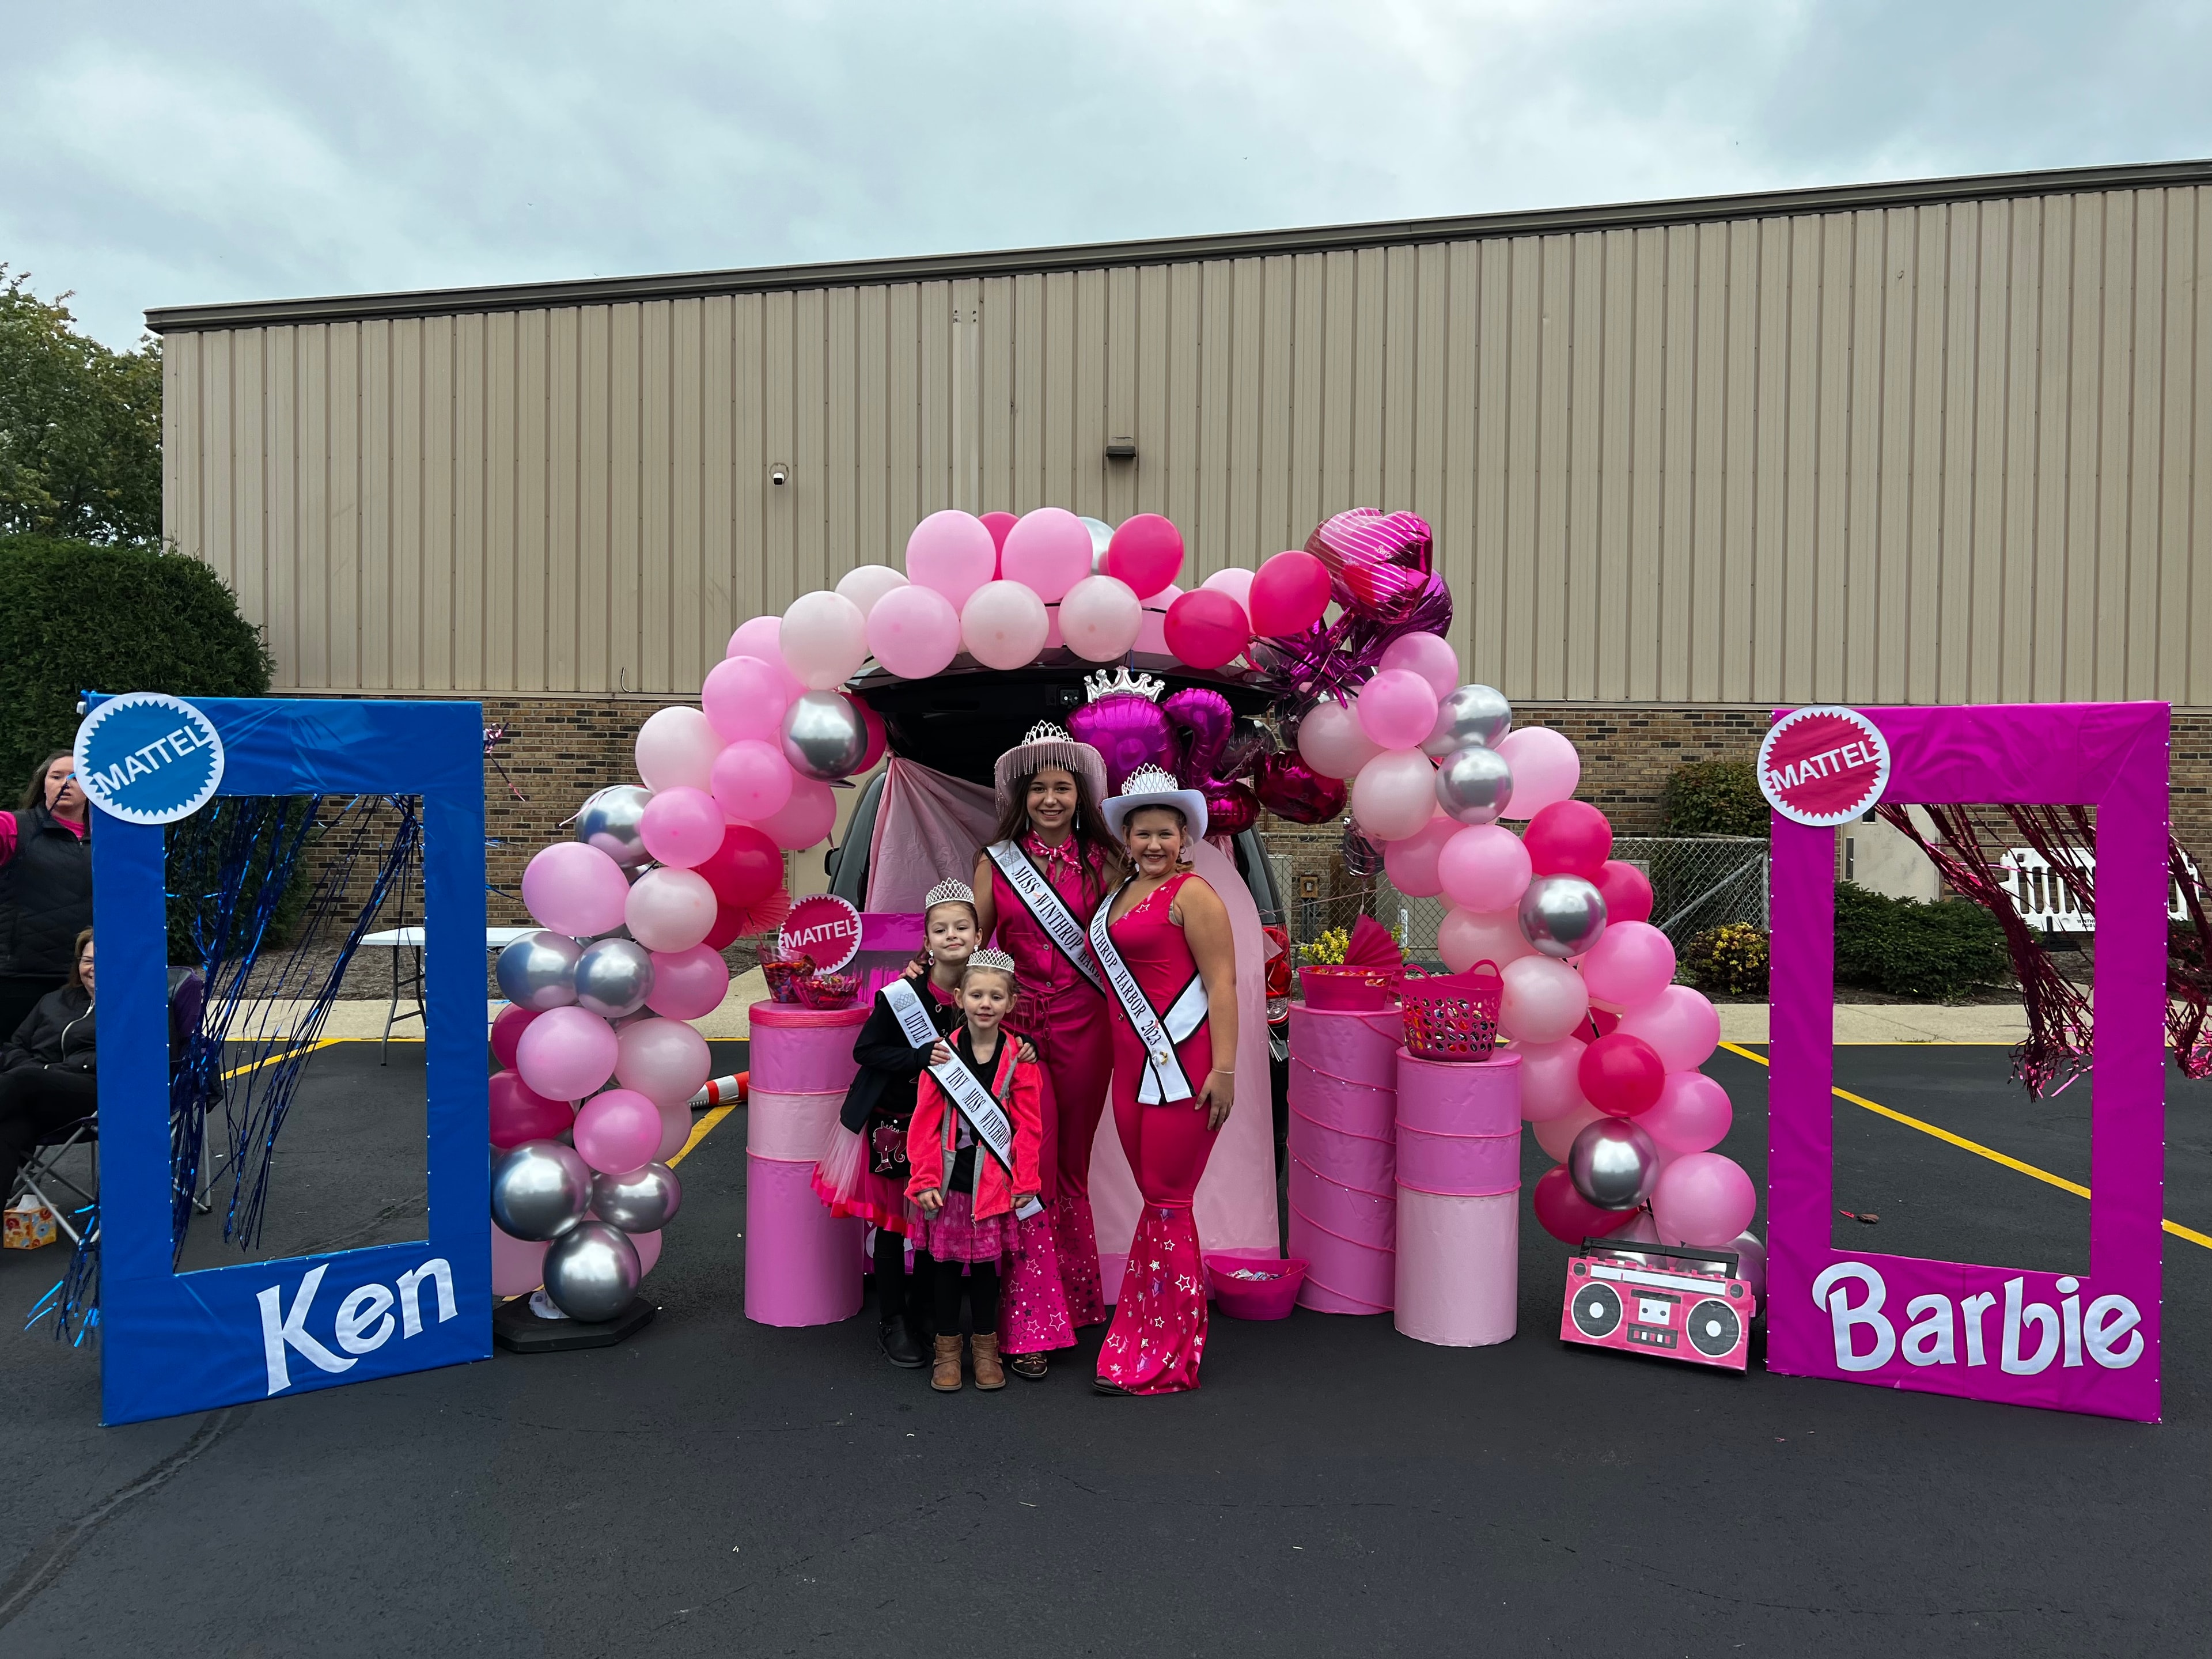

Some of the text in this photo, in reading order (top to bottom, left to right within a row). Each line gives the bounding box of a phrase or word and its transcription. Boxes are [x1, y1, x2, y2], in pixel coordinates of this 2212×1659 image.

[93, 725, 212, 796] MATTEL
[1771, 741, 1877, 791] MATTEL
[783, 919, 858, 949] MATTEL
[1012, 865, 1041, 894] MISS
[1034, 892, 1084, 950] WINTHROP
[1092, 912, 1118, 968] WINTHROP
[1115, 971, 1147, 1020] HARBOR
[1141, 1020, 1161, 1046] 2023
[904, 1011, 932, 1043] LITTLE
[946, 1067, 1010, 1150] TINY MISS WINTHROP
[256, 1258, 458, 1396] Ken
[1812, 1262, 2144, 1375] Barbie
